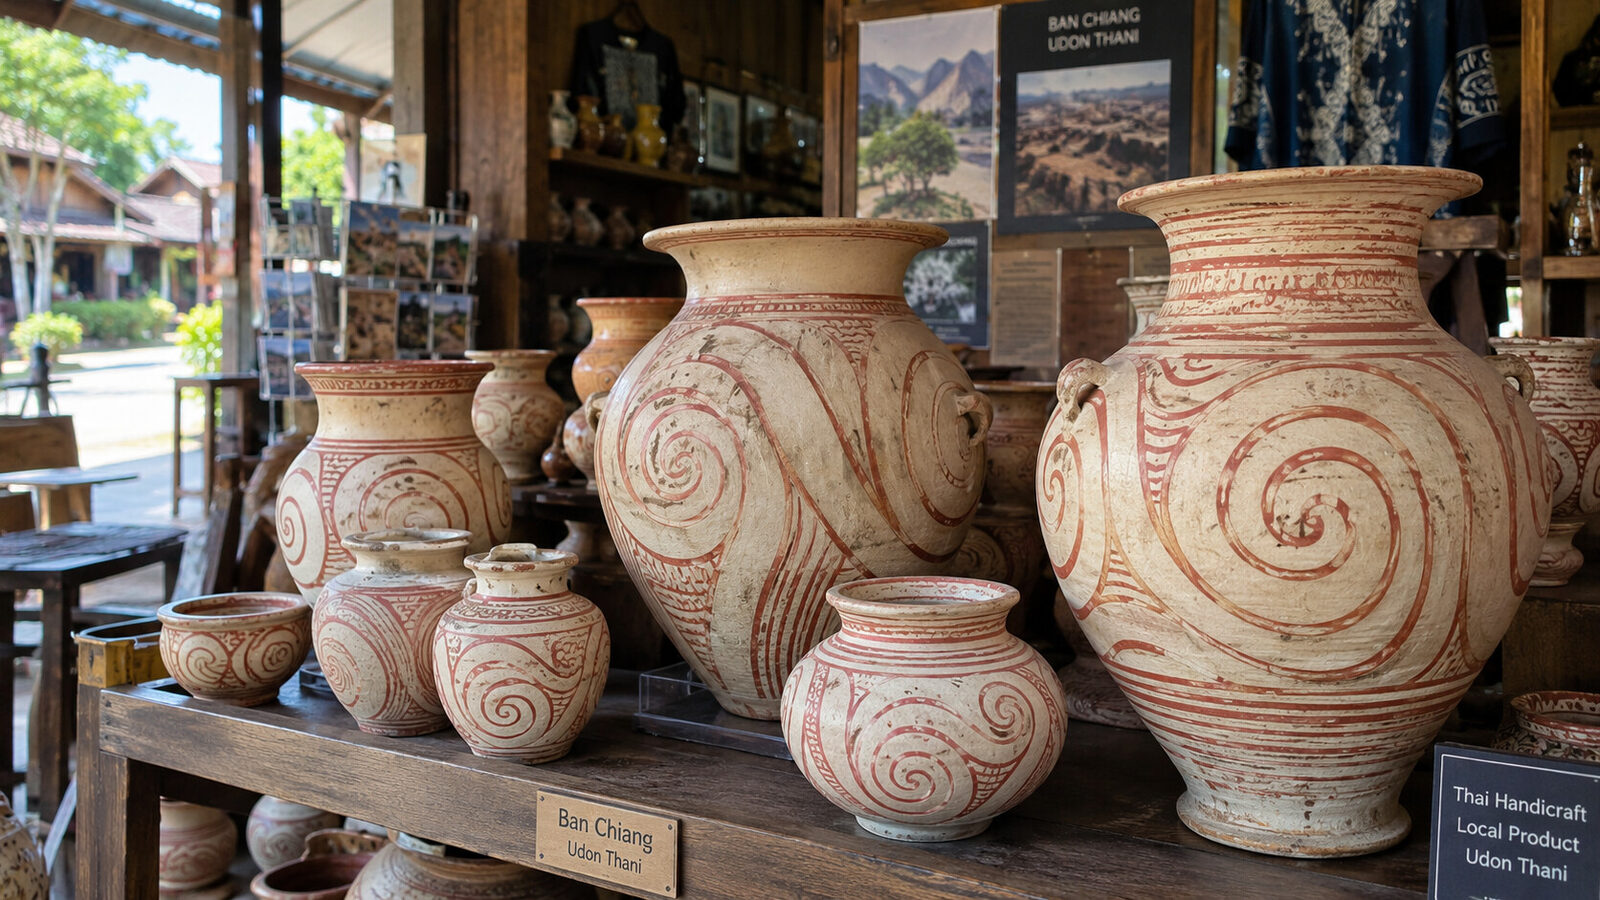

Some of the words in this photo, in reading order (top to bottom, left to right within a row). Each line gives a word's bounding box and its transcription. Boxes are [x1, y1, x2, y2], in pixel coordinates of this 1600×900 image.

[1048, 14, 1079, 32] BAN
[1082, 6, 1141, 28] CHIANG
[1048, 34, 1091, 52] UDON
[1094, 29, 1140, 47] THANI
[1453, 785, 1489, 807] Thai
[1495, 792, 1588, 823] Handicraft
[558, 808, 589, 833] Ban
[594, 817, 653, 854] Chiang
[1457, 816, 1502, 840] Local
[1508, 825, 1580, 854] Product
[567, 840, 602, 863] Udon
[605, 849, 642, 874] Thani
[1466, 847, 1512, 872] Udon
[1517, 856, 1568, 882] Thani
